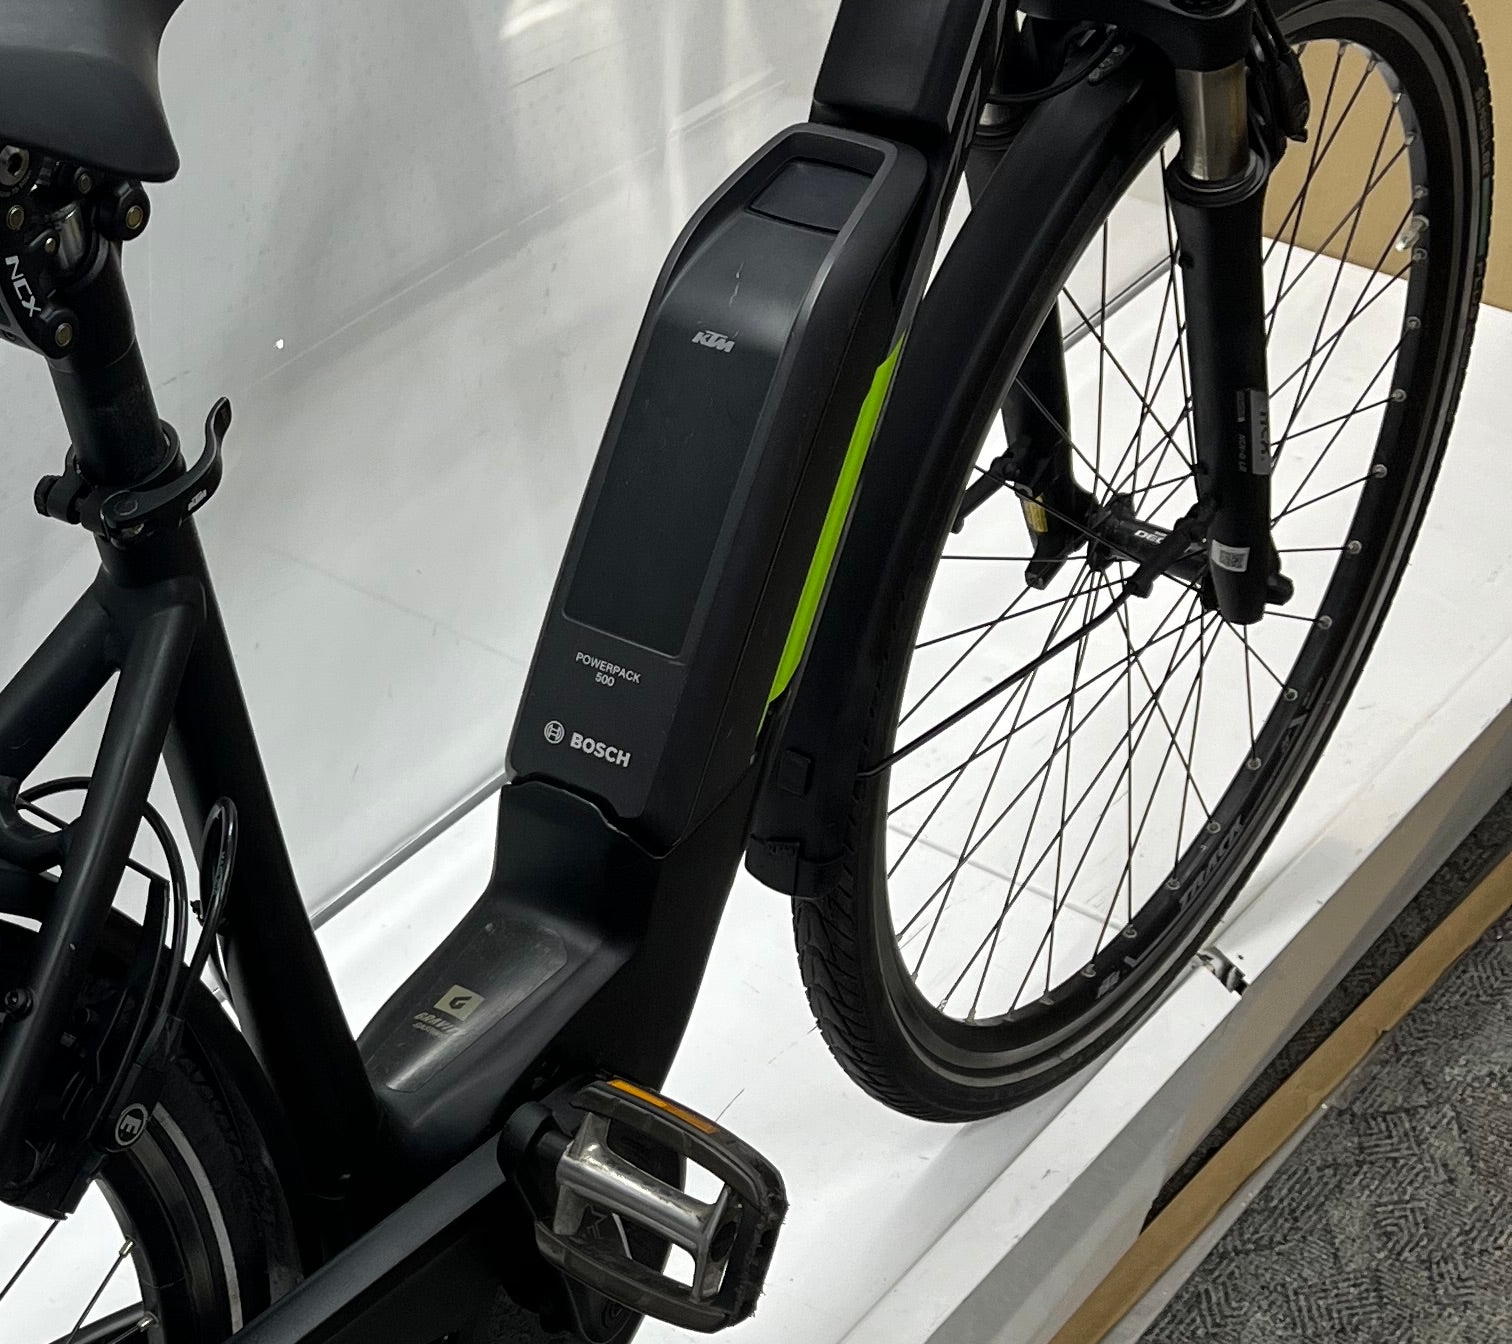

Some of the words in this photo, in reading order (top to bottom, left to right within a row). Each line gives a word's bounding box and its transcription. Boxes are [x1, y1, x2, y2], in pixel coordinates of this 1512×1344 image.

[5, 255, 42, 317] NCX
[691, 329, 735, 353] KTM
[575, 651, 642, 684] POWERPACK
[595, 671, 615, 687] 500
[570, 732, 631, 768] BOSCH
